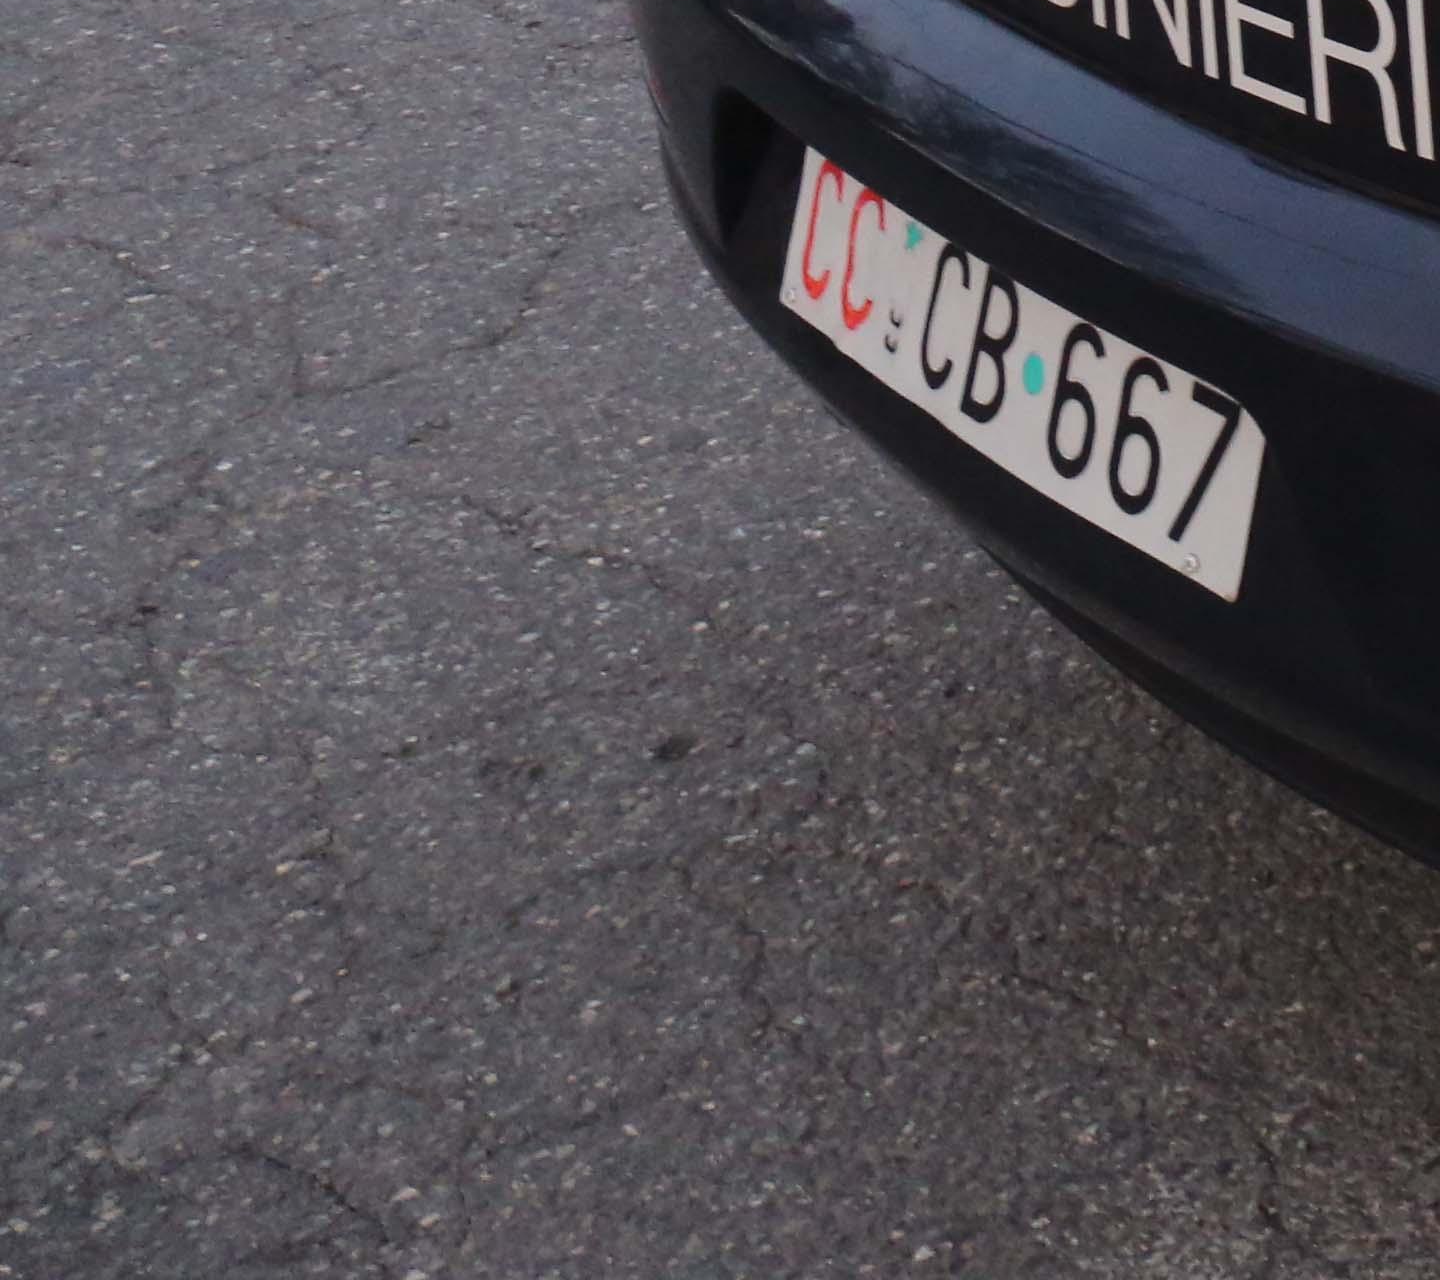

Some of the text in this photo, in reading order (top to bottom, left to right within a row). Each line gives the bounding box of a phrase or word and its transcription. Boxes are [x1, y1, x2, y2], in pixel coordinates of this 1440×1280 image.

[801, 158, 1243, 543] CC CB 667
